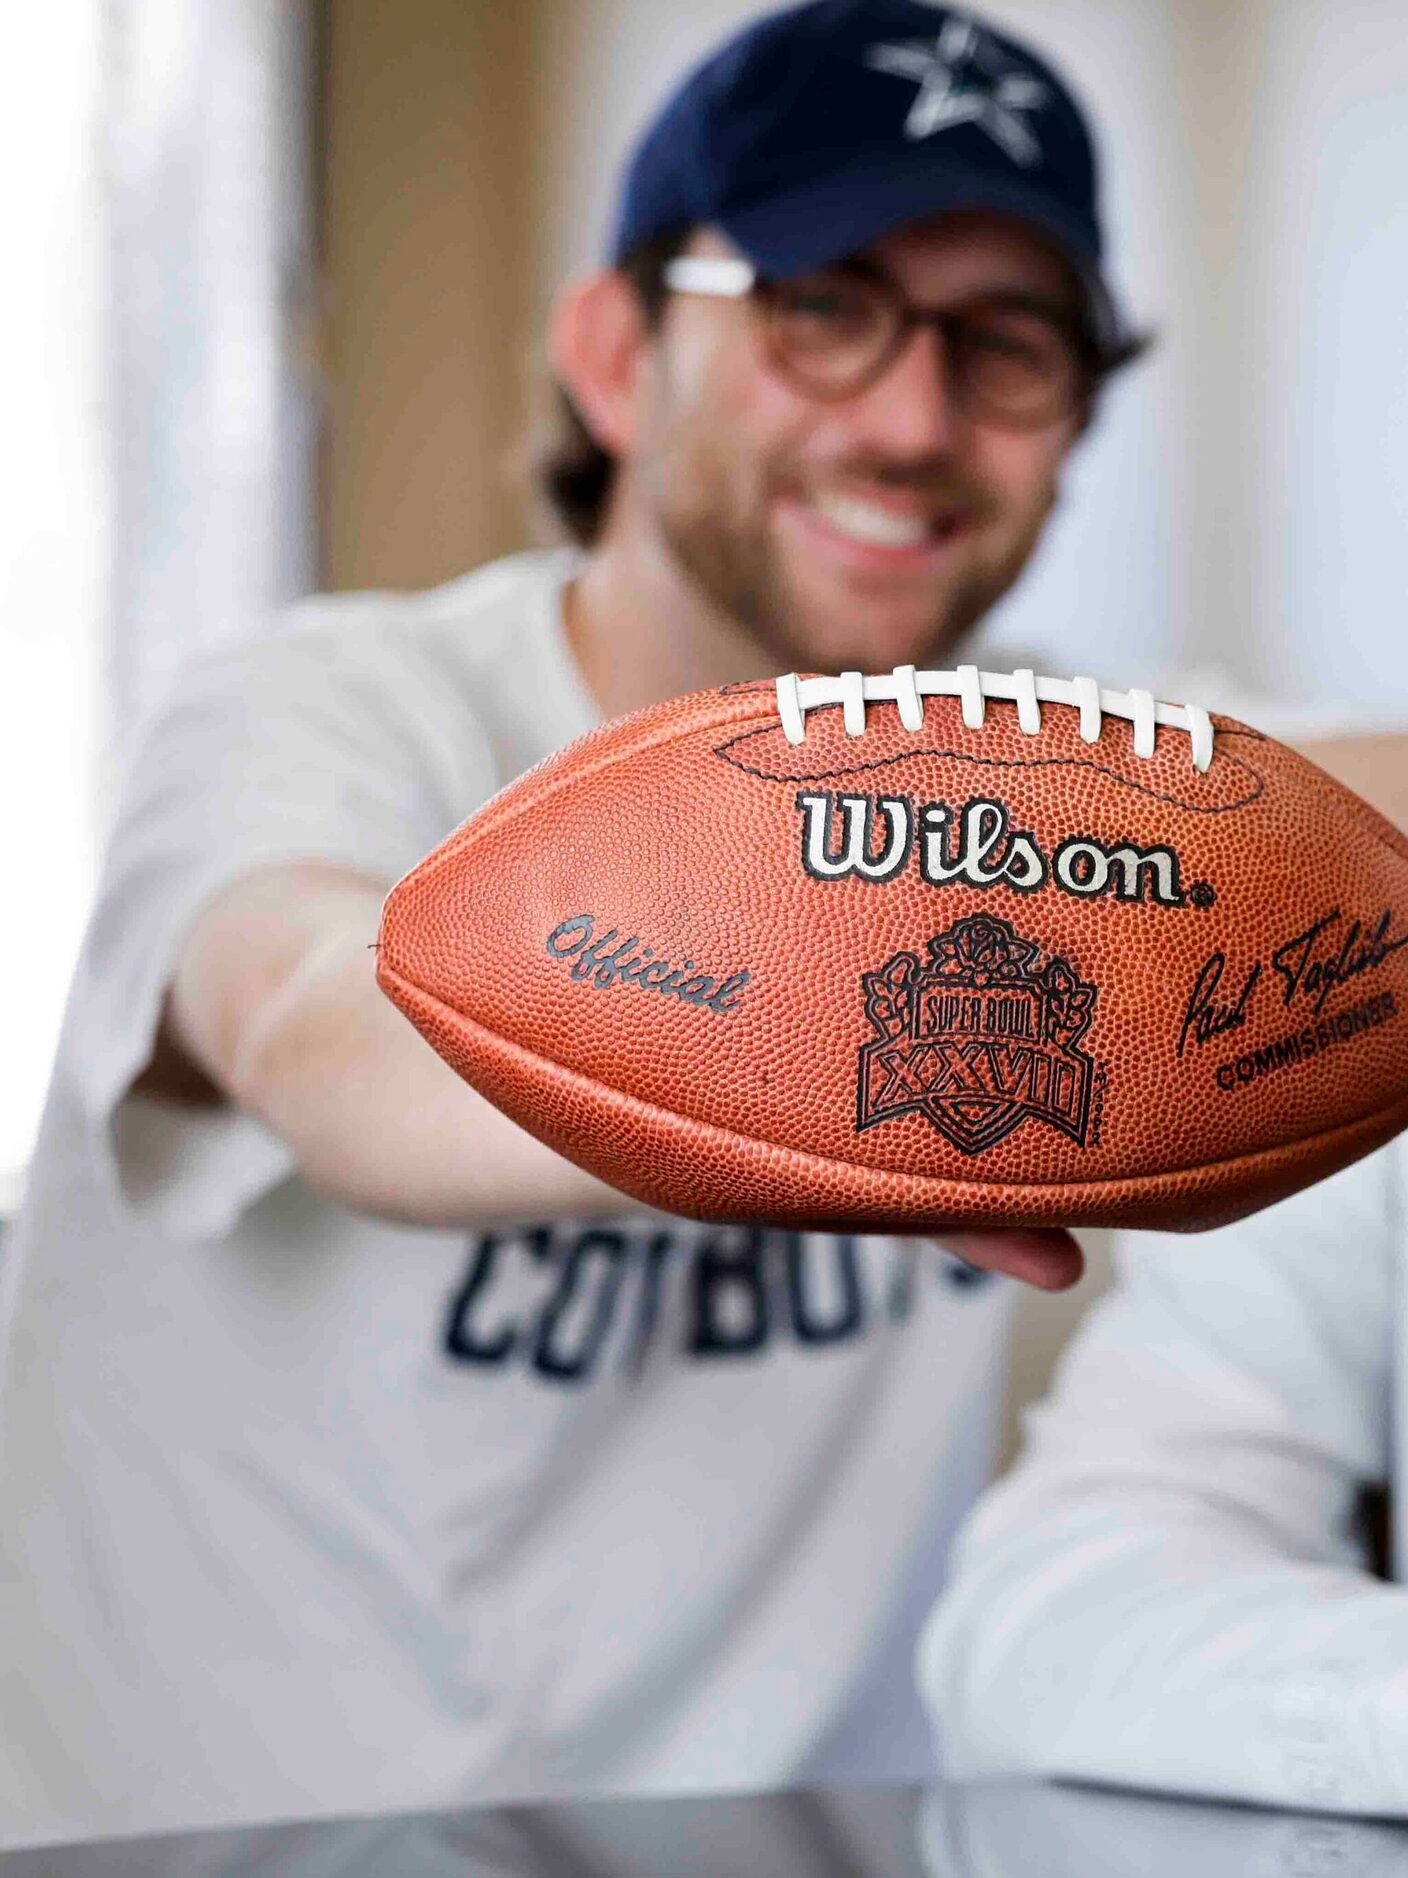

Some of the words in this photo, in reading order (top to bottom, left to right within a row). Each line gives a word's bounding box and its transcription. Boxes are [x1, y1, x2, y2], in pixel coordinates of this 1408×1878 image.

[797, 791, 1187, 907] Wilson
[546, 913, 752, 1014] Official
[927, 994, 983, 1033] SUPER
[986, 996, 1034, 1036] BOWL
[1215, 991, 1399, 1091] COMMISSIONER
[872, 1041, 1077, 1119] XXVII
